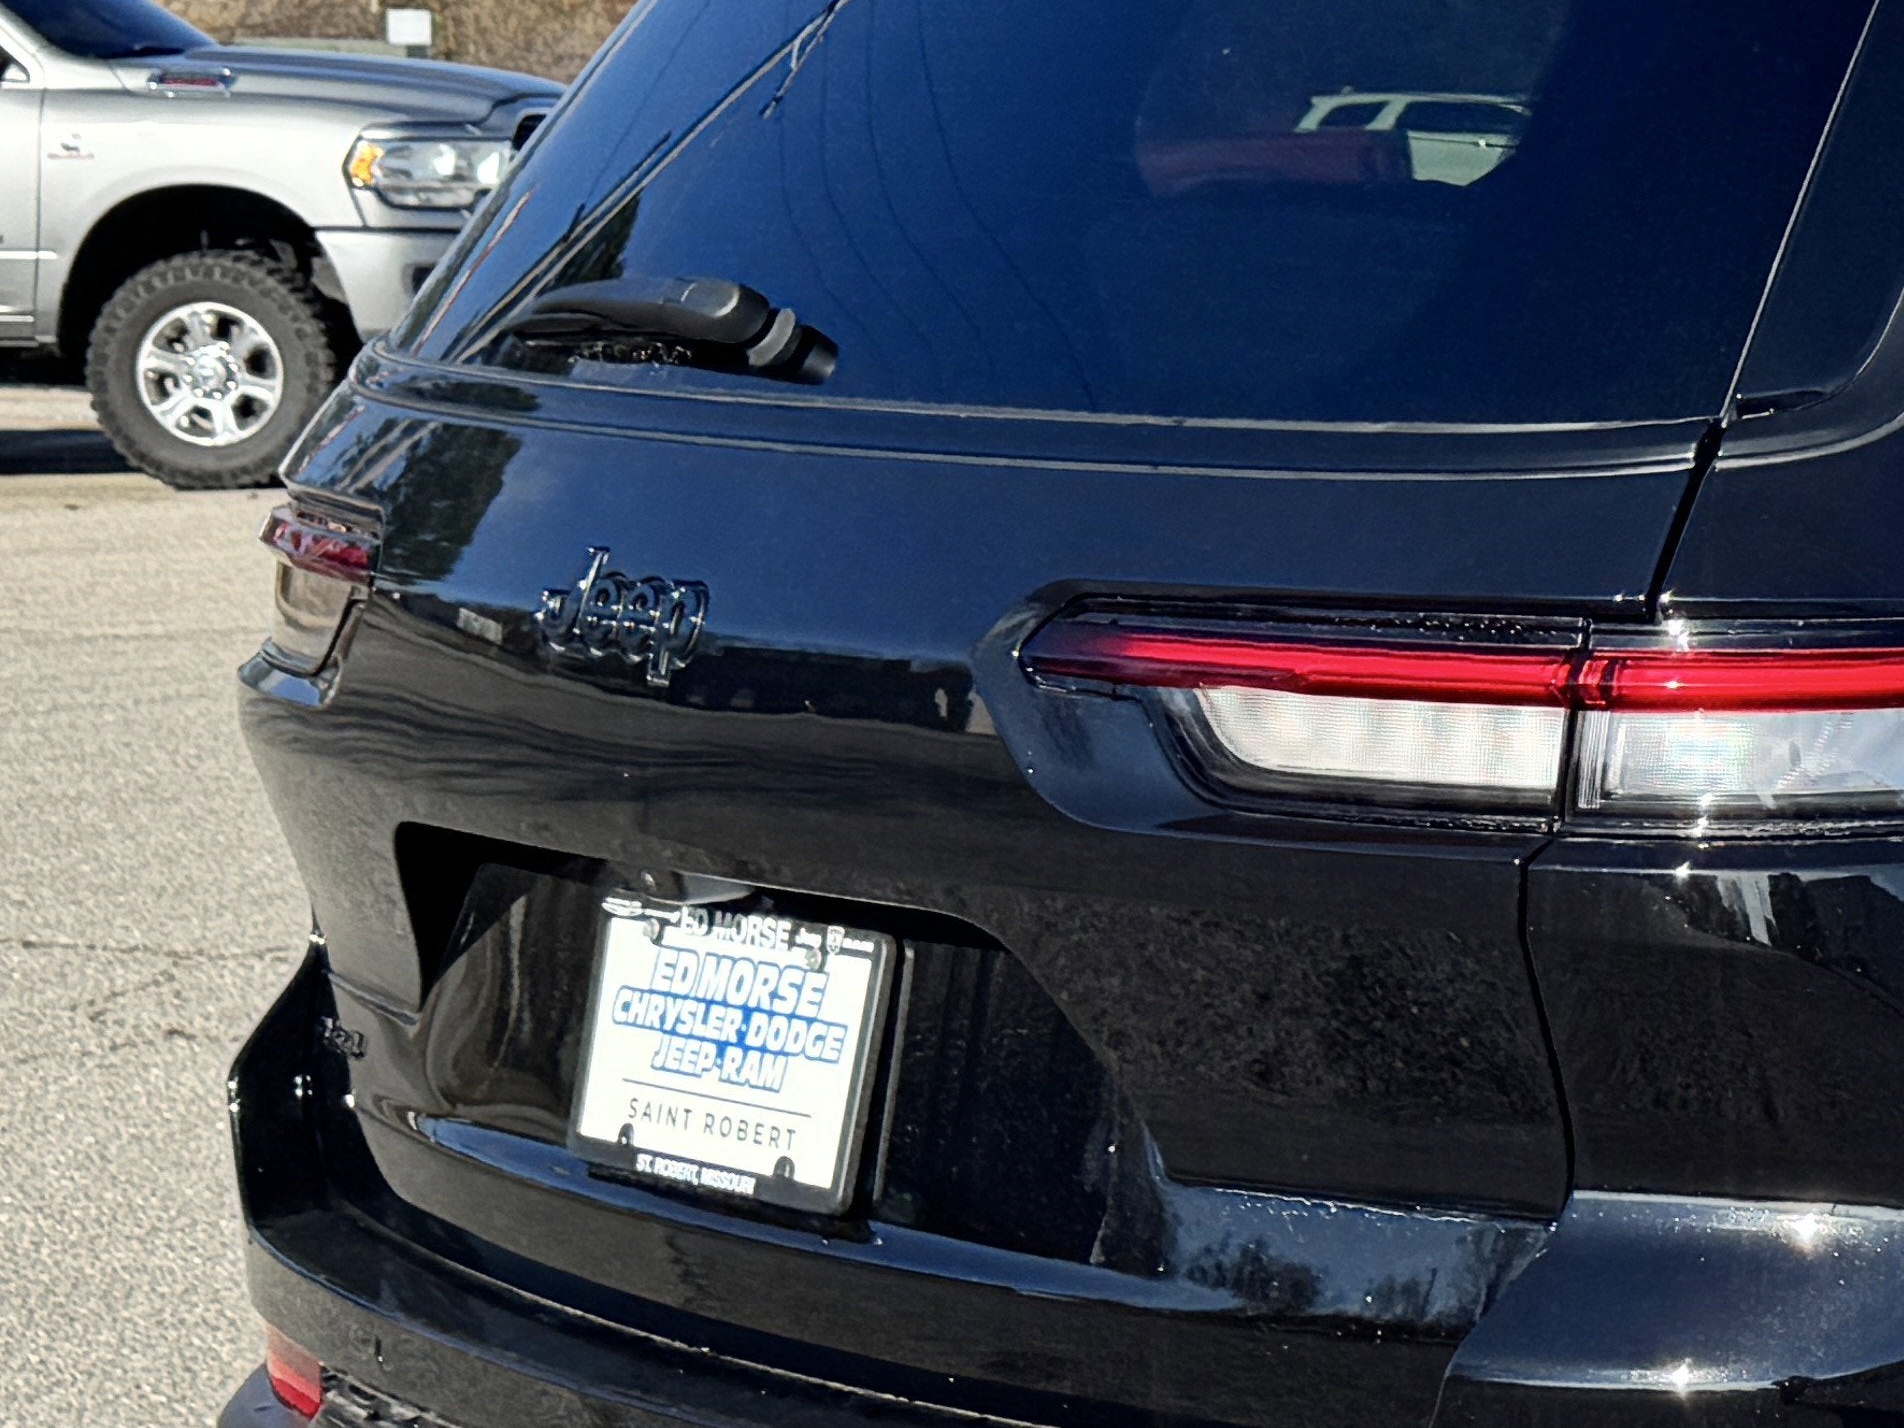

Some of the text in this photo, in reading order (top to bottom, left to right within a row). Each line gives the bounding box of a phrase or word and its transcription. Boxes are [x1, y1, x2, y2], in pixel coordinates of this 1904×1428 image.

[533, 546, 710, 689] Jeep
[714, 910, 792, 950] MORSE
[651, 947, 830, 1019] ED MORSE
[627, 1097, 797, 1151] SAINT ROBERT
